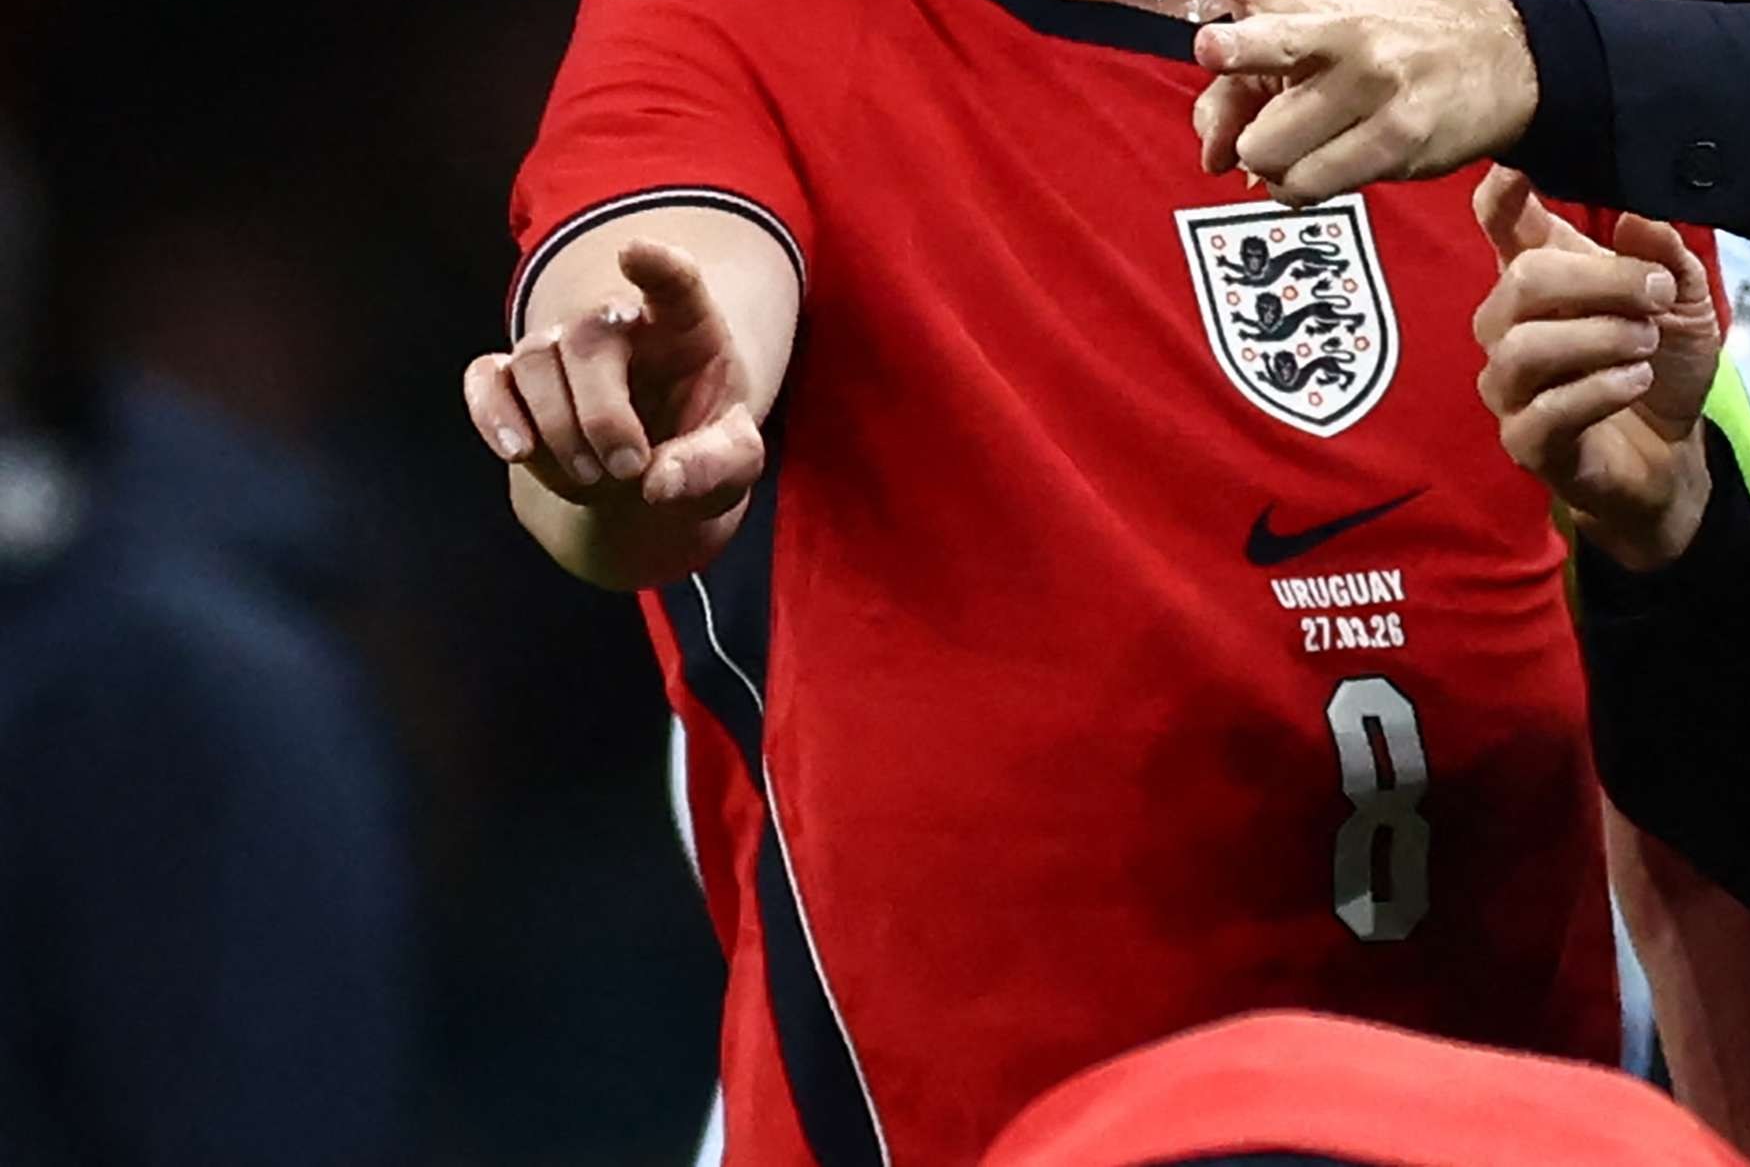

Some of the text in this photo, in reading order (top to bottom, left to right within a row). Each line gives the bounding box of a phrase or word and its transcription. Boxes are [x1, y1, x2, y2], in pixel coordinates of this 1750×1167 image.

[1270, 568, 1405, 609] URUGUAY
[1300, 612, 1405, 652] 27.03.26
[1326, 677, 1429, 941] 8
